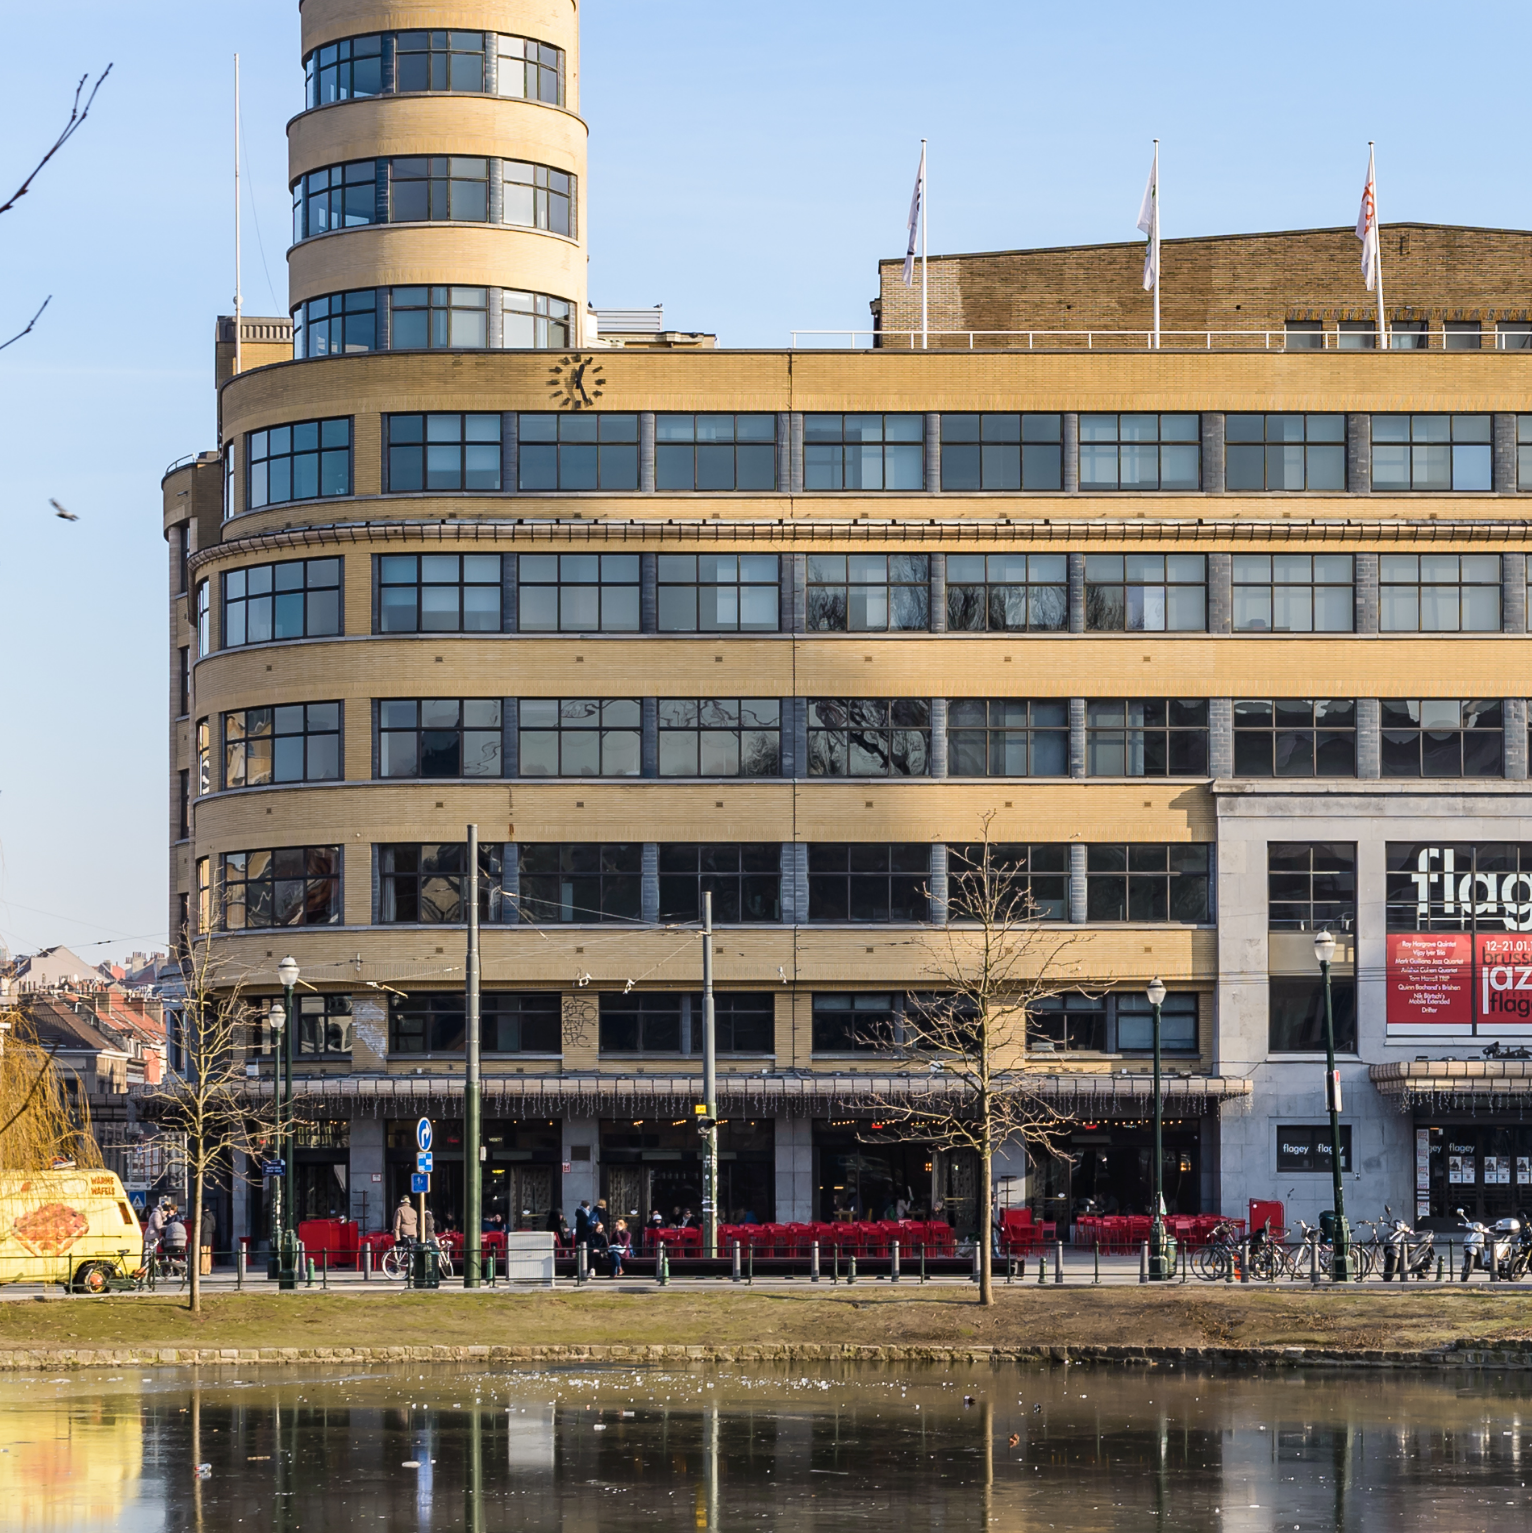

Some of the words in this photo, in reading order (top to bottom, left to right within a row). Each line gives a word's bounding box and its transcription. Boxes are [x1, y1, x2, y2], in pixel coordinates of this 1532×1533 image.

[1283, 1144, 1309, 1154] flagey
[1318, 1144, 1344, 1154] flagy
[1449, 1143, 1475, 1154] flagey
[91, 1187, 115, 1195] WAFELS
